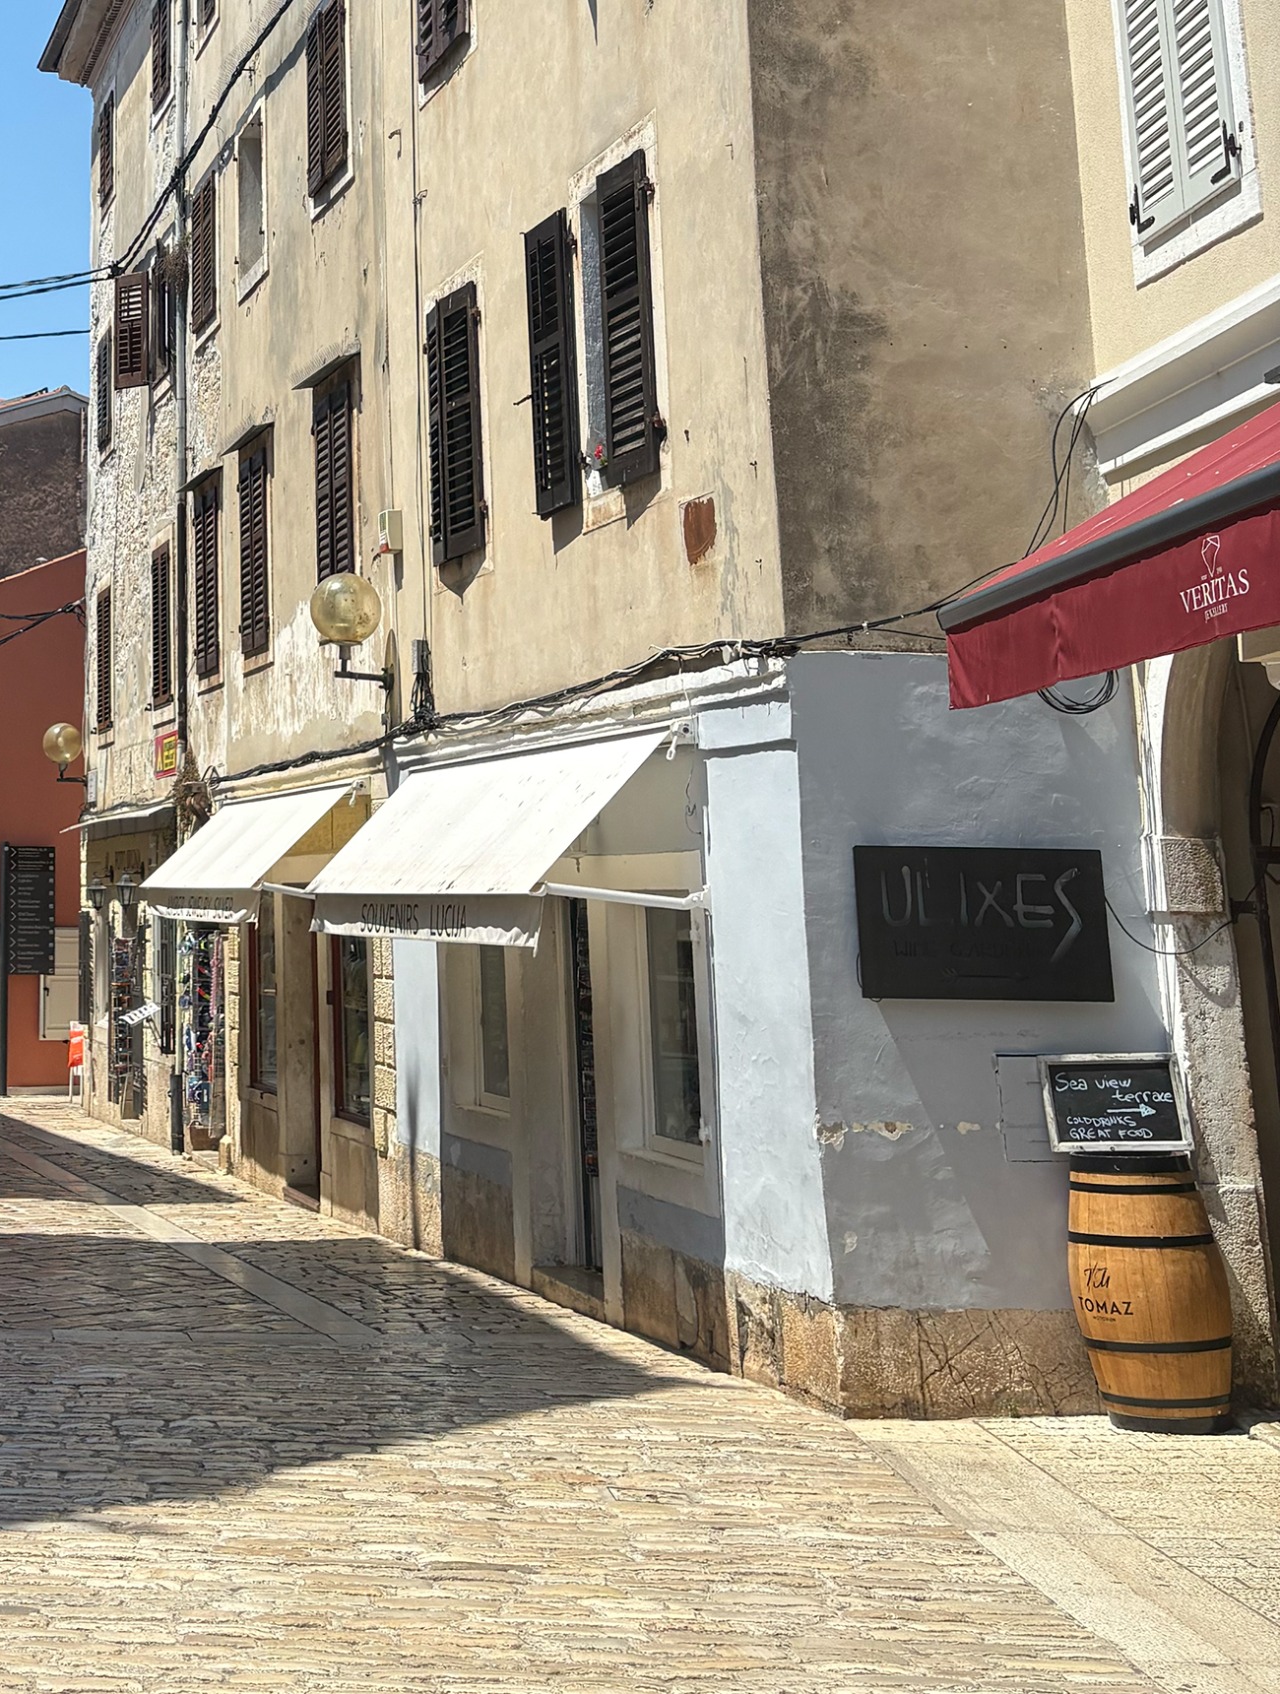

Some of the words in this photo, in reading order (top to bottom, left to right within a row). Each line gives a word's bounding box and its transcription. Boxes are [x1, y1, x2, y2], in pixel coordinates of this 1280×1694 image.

[1180, 568, 1250, 613] VERITAS
[360, 903, 419, 935] SOUVENIRS
[429, 904, 468, 938] LUCIJA
[881, 865, 1083, 963] ULIXES
[1055, 1072, 1088, 1091] Sea
[1095, 1074, 1131, 1090] view
[1111, 1090, 1174, 1103] terrace
[1070, 1128, 1111, 1140] GREAT
[1118, 1128, 1153, 1139] FOOD
[1078, 1296, 1134, 1315] TOMAZ
